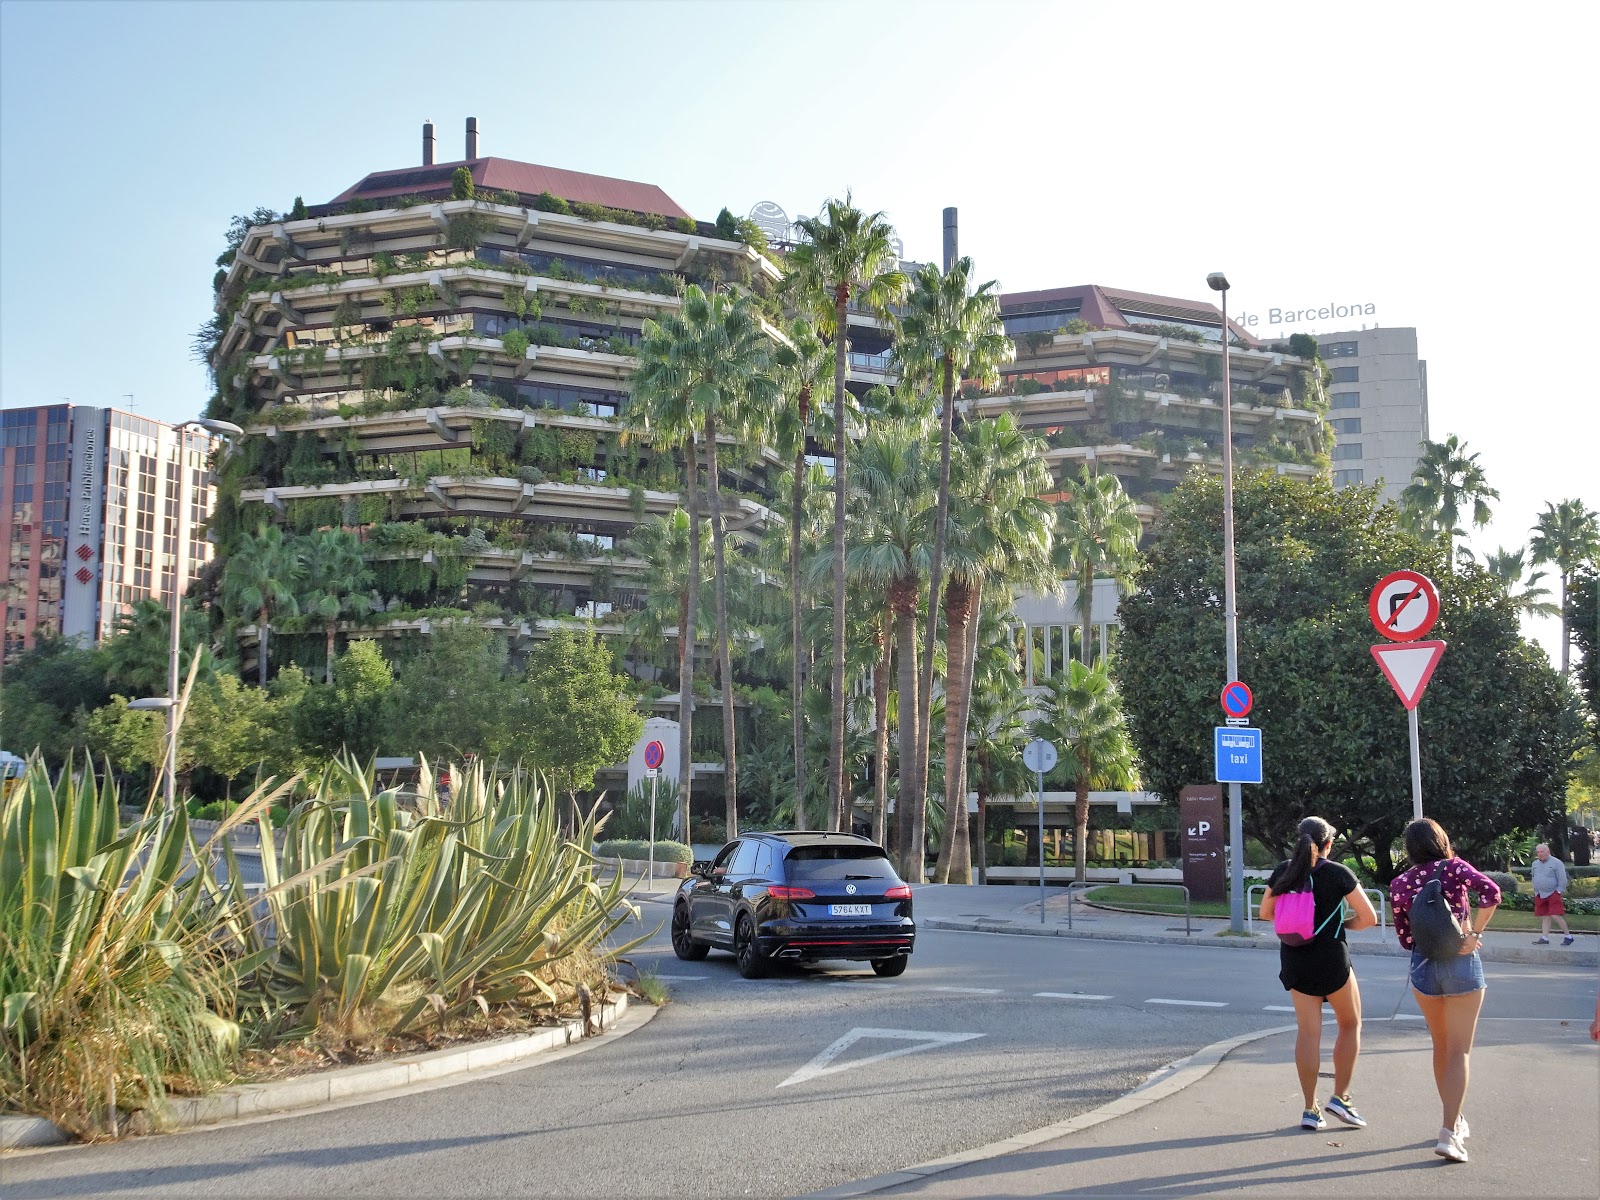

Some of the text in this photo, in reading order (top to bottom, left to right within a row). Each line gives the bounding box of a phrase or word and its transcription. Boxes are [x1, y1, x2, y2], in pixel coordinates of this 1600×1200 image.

[1235, 303, 1375, 327] de Barcelona
[81, 428, 95, 499] Publicaciones
[1231, 753, 1248, 764] taxi
[1199, 821, 1210, 835] P
